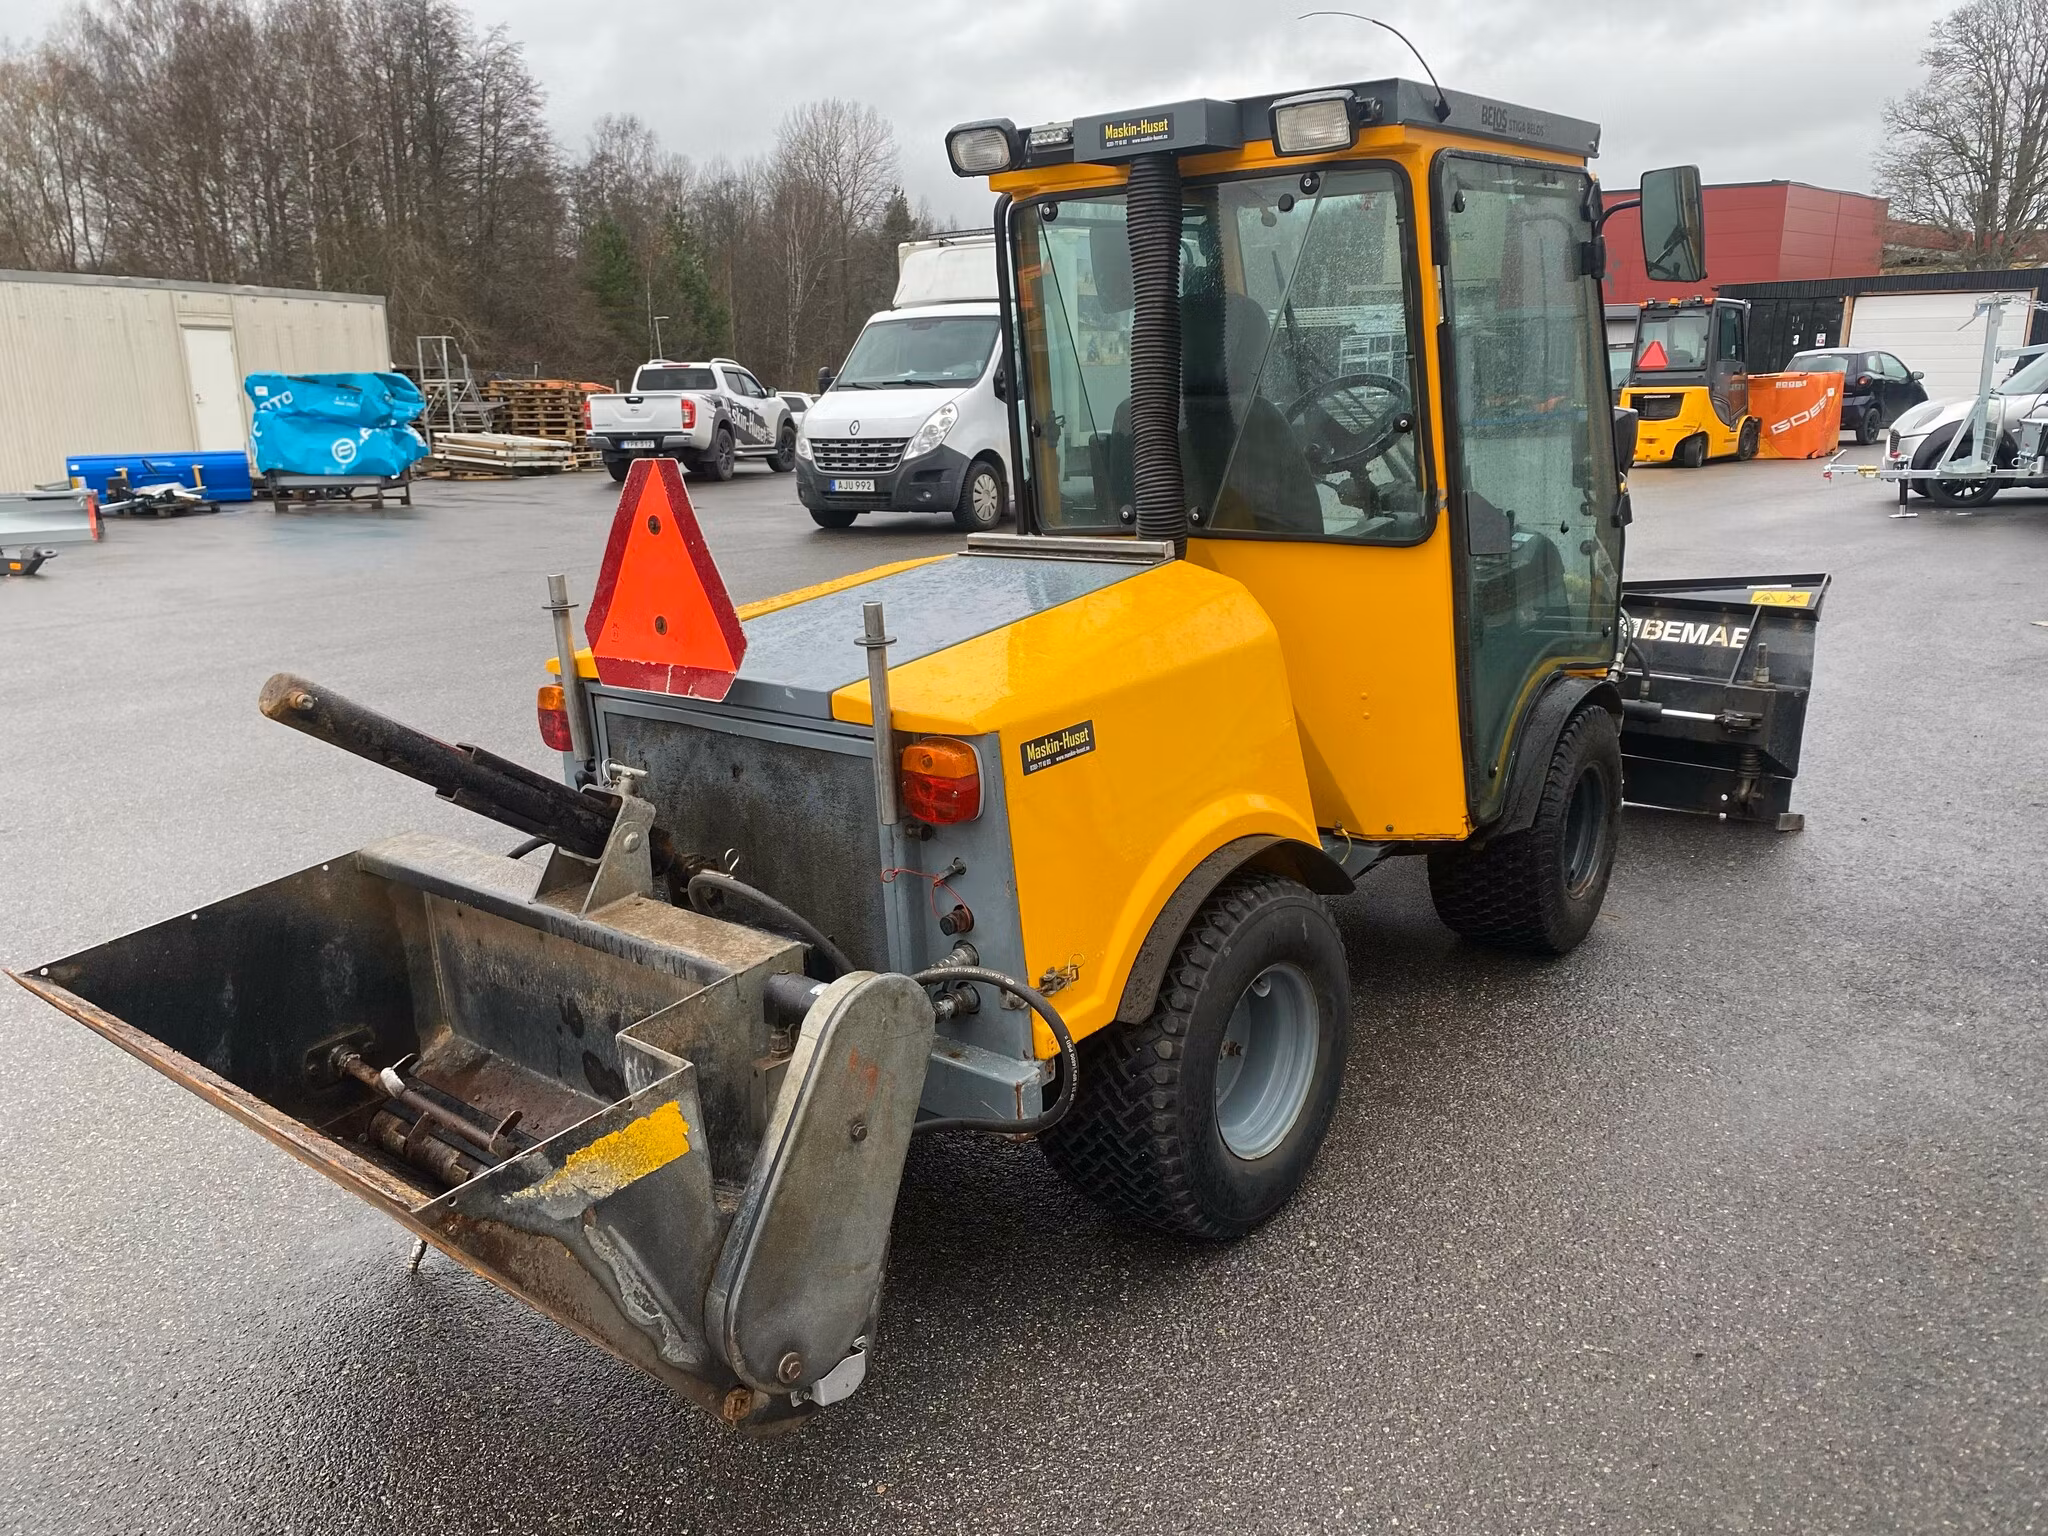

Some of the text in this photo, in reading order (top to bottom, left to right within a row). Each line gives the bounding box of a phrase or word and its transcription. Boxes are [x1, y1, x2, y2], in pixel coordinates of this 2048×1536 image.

[1105, 118, 1168, 140] Maskin-Huset
[1792, 334, 1800, 345] 3
[1771, 394, 1827, 434] GOES
[838, 481, 872, 490] AJU 992
[1026, 727, 1090, 762] Maskin-Huset
